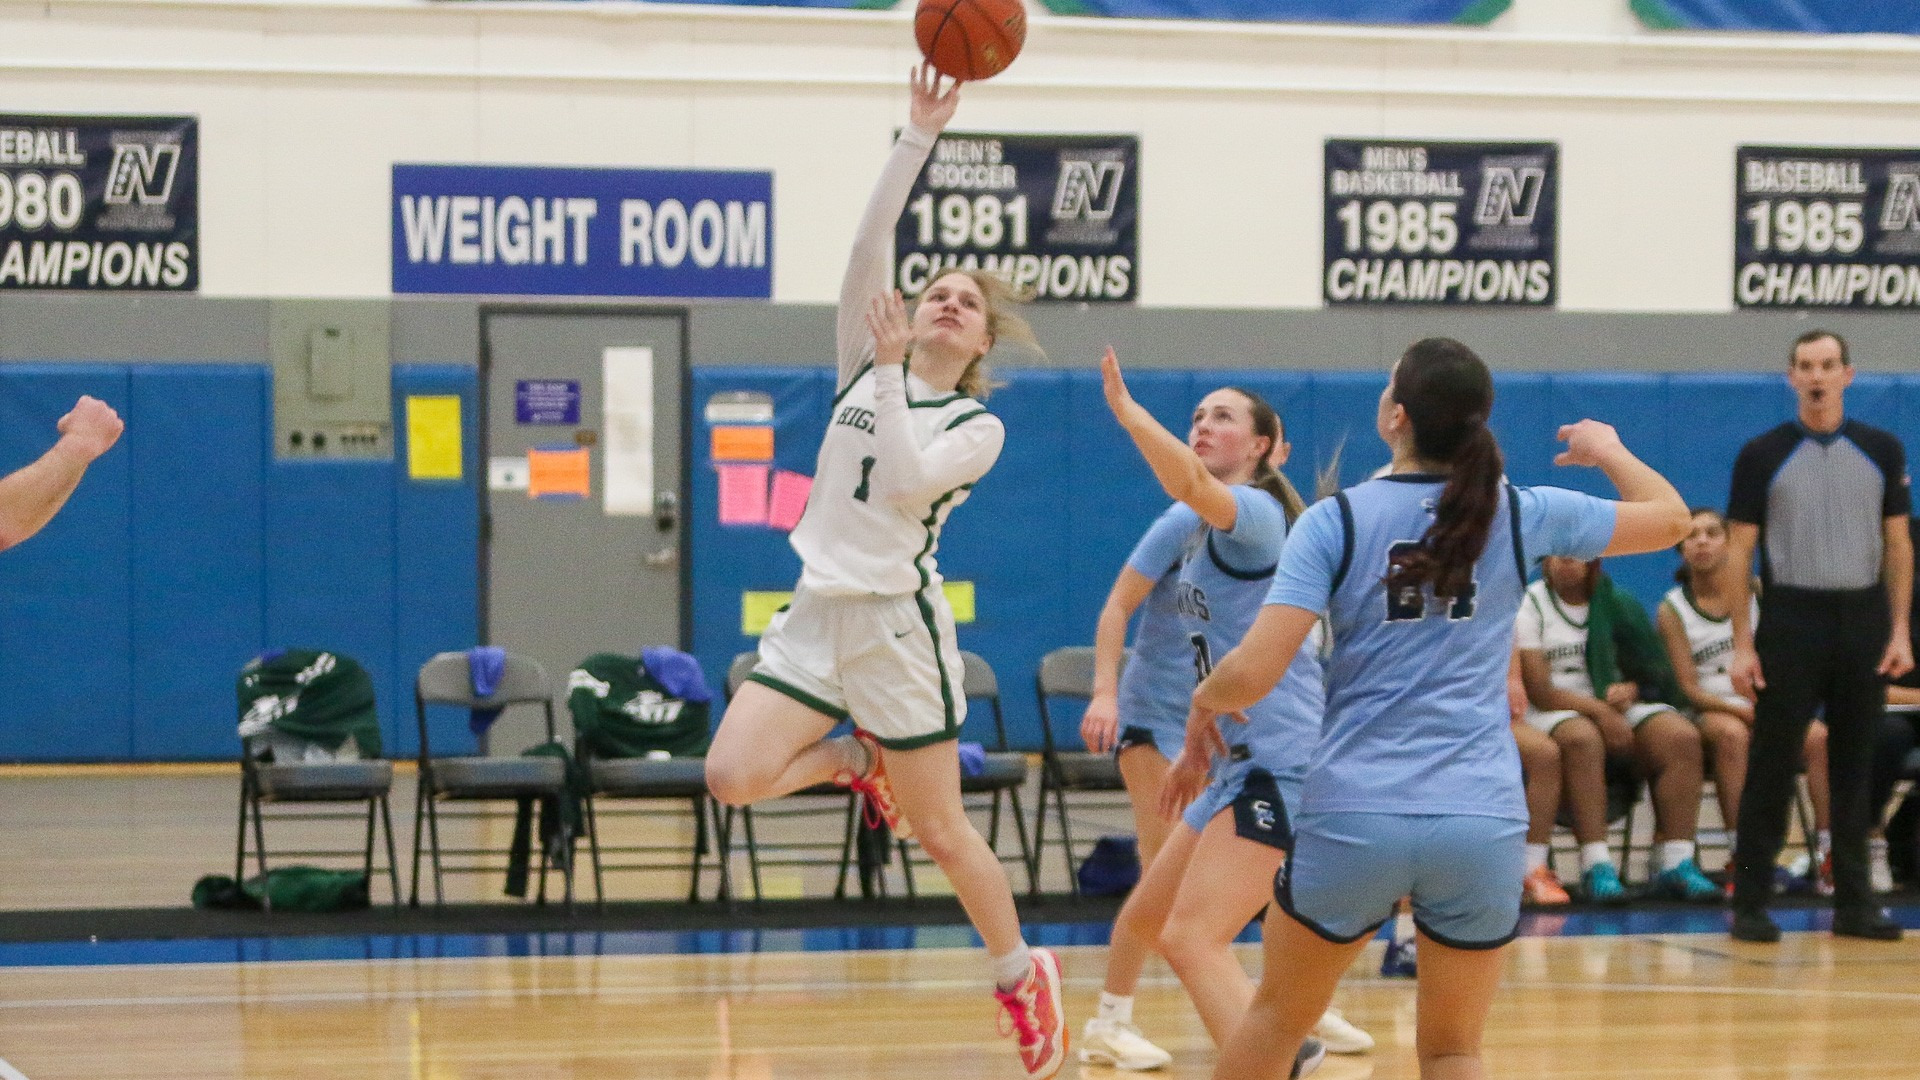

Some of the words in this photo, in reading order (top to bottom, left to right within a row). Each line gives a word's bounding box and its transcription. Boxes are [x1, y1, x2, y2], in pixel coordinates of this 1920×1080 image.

[927, 163, 1017, 189] SOCCER
[1330, 170, 1464, 196] BASKETBALL
[1745, 160, 1867, 194] BASEBALL
[401, 195, 598, 265] WEIGHT
[620, 199, 765, 268] ROOM
[910, 193, 1028, 248] 1981
[1336, 200, 1458, 253] 1985
[1746, 200, 1864, 253] 1985
[0, 240, 190, 287] AMPIONS
[1327, 258, 1550, 301] CHAMPIONS
[854, 456, 876, 502] 1
